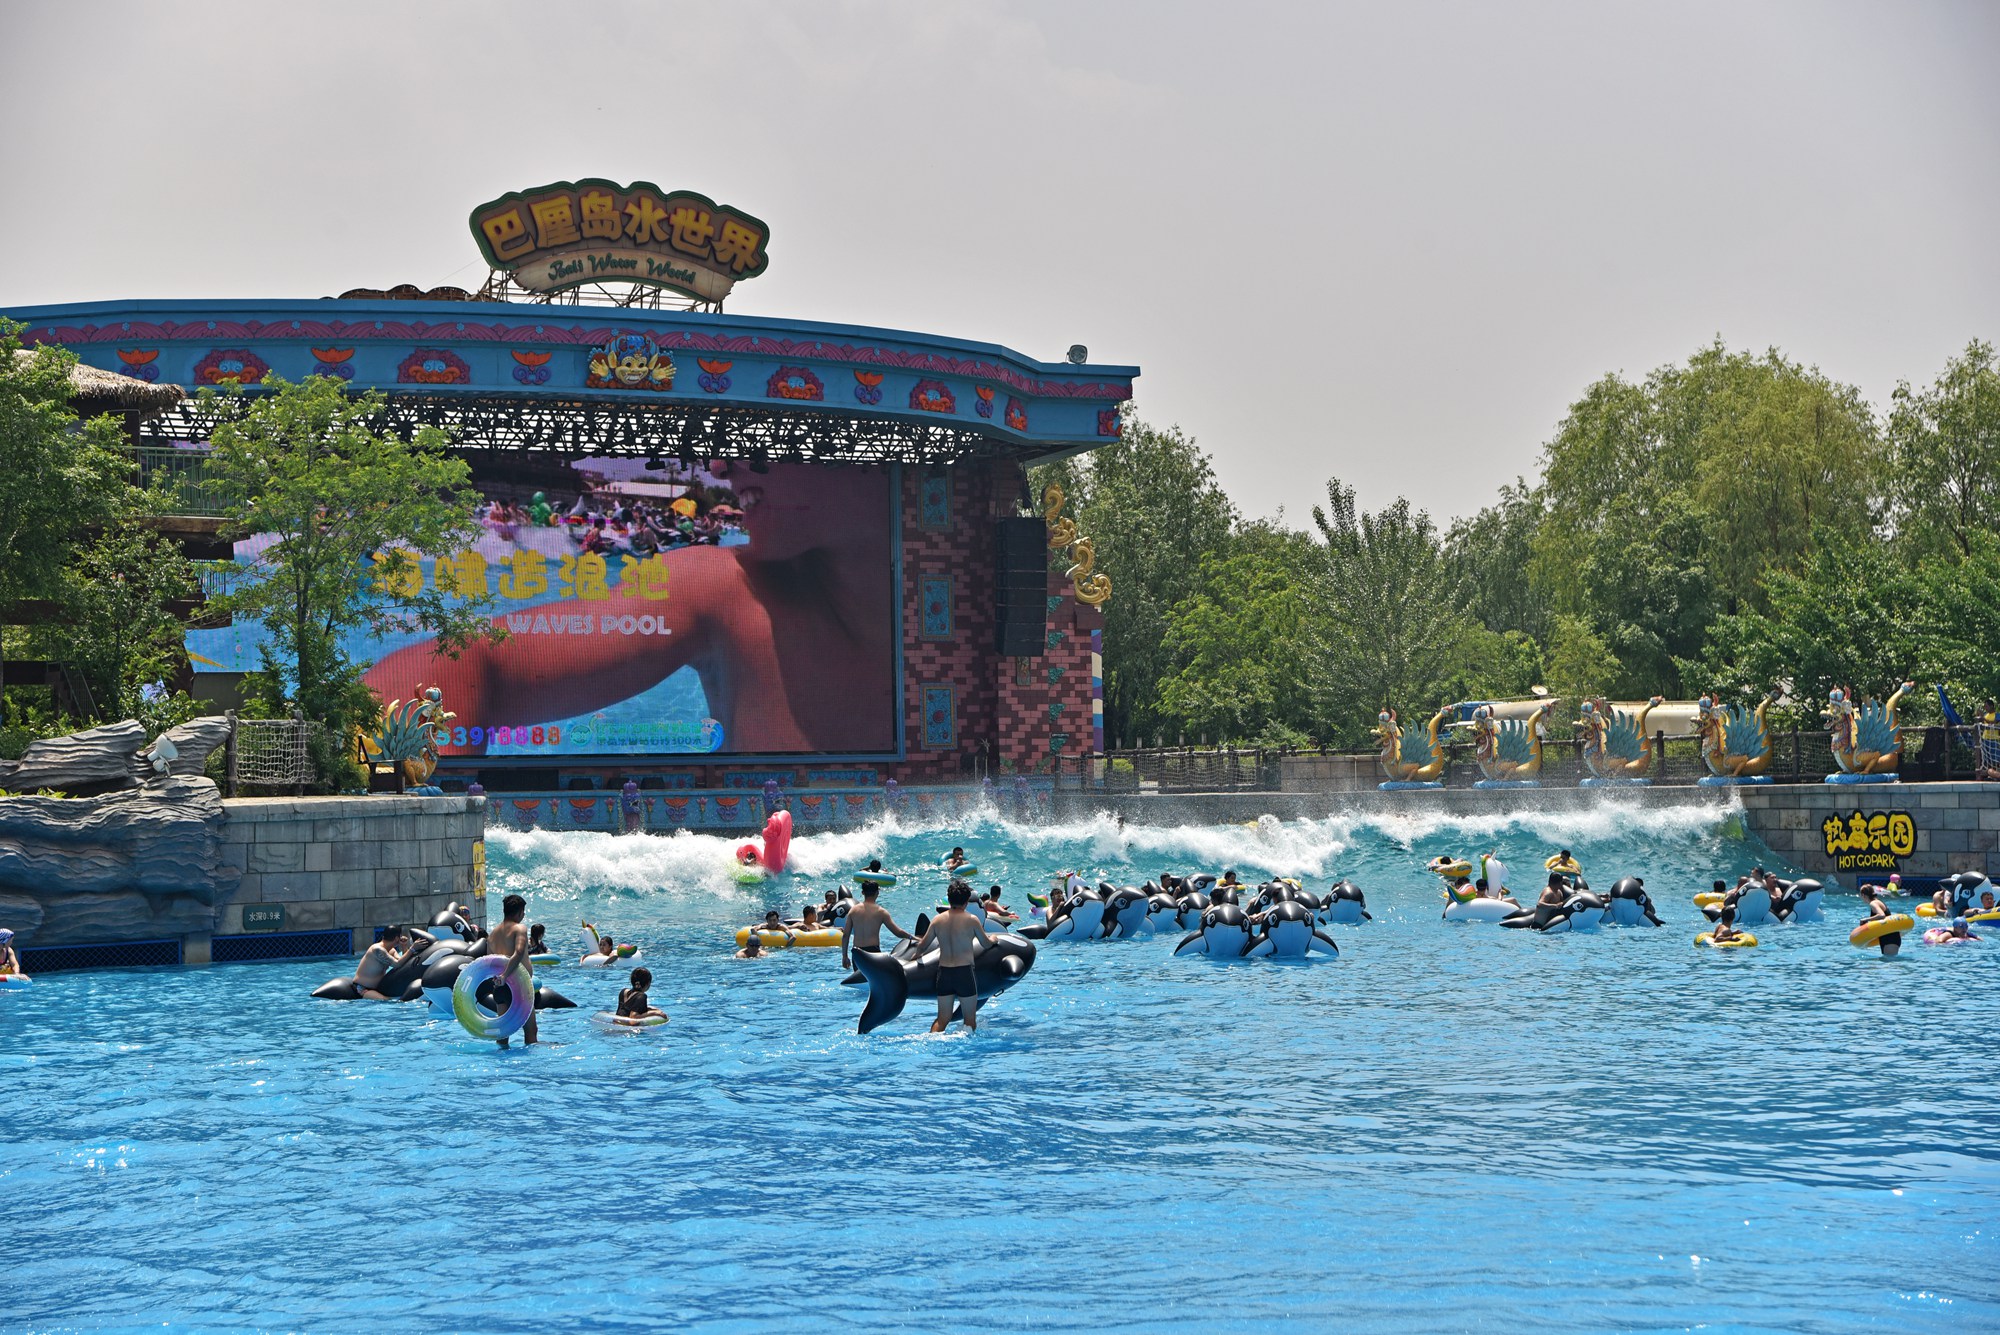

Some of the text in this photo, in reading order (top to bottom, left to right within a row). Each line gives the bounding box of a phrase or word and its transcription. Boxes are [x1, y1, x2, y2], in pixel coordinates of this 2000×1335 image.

[482, 190, 761, 272] 巴厘岛水世界
[548, 252, 696, 284] Bali Water World
[507, 614, 594, 635] WAVES
[601, 614, 672, 635] POOL
[436, 725, 561, 747] 53918888
[1824, 812, 1915, 856] 热高乐园
[1839, 855, 1855, 868] HOT
[248, 911, 281, 922] 水深0.9米
